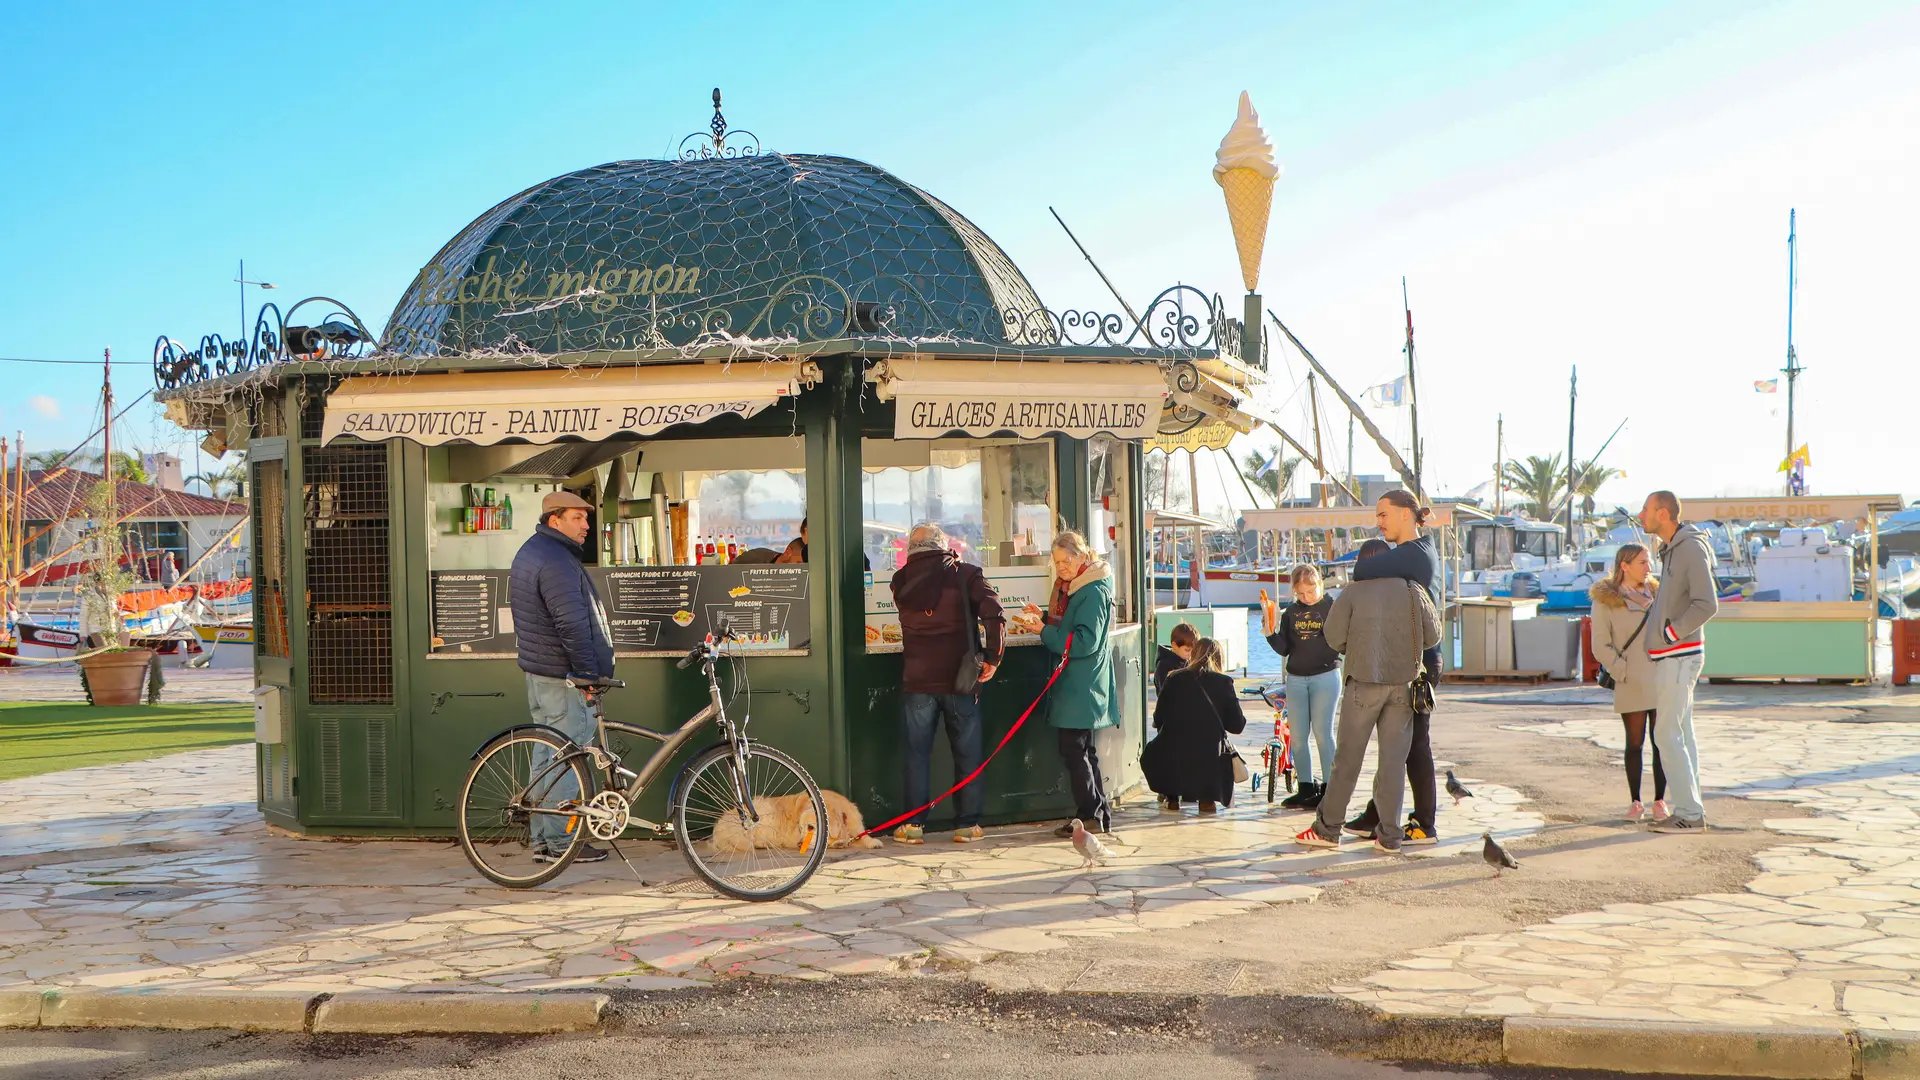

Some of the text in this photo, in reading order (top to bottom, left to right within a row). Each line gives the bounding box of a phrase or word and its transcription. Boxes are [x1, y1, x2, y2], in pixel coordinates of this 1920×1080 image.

[417, 256, 701, 314] Péché mignon
[341, 410, 486, 436] SANDWICH
[505, 407, 601, 436] PANINI
[621, 400, 751, 430] BOISSONS
[911, 401, 1147, 429] GLACES ARTISANALES
[1296, 512, 1376, 526] PASTISSO
[876, 601, 895, 609] Tout
